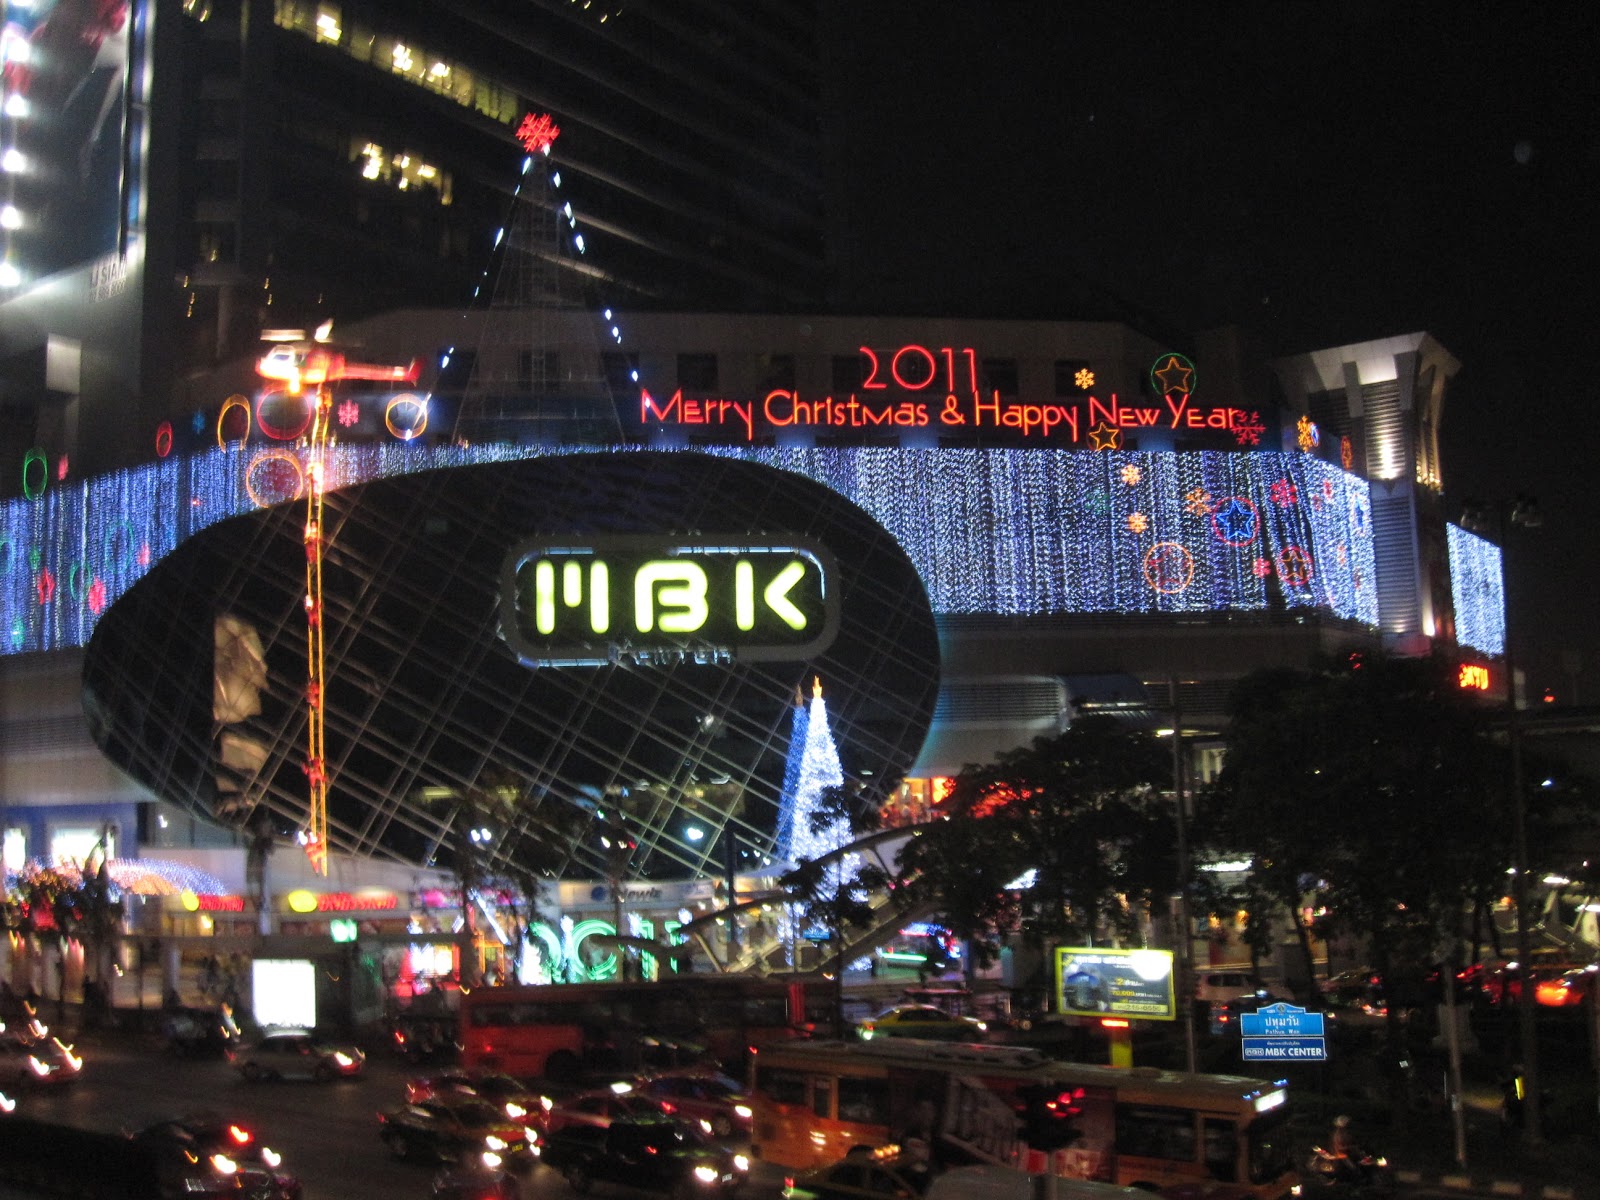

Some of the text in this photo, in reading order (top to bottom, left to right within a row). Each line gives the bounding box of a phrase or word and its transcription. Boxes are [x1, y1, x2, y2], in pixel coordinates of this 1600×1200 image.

[860, 345, 976, 392] 2011
[641, 388, 752, 441] Merry
[764, 389, 929, 427] Christmas
[940, 394, 965, 425] &
[975, 389, 1077, 442] Happy
[1089, 393, 1160, 428] New
[536, 560, 807, 634] MBK
[1265, 1015, 1299, 1029] ปทุมวัน
[1265, 1047, 1286, 1056] MBK
[1288, 1047, 1322, 1056] CENTER
